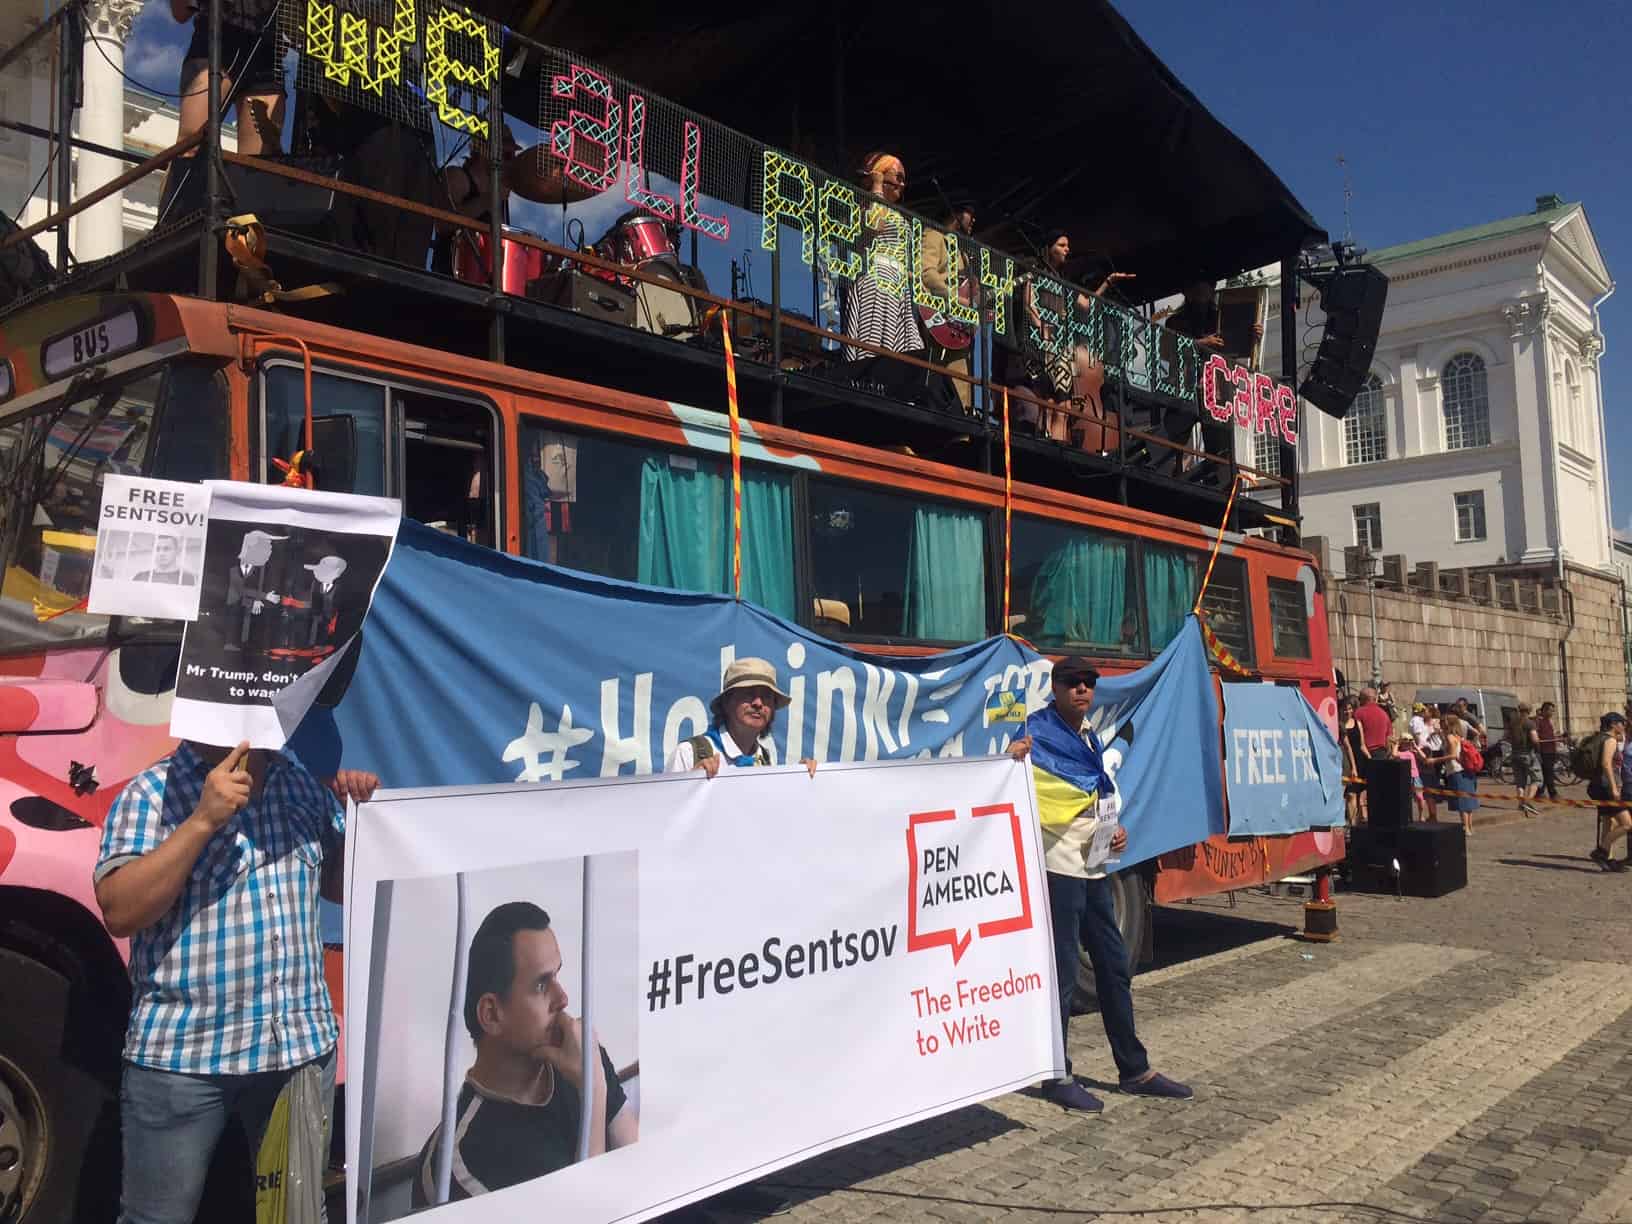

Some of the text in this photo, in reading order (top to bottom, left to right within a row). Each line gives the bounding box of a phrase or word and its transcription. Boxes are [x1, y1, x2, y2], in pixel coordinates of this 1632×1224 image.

[73, 325, 109, 362] BUS
[103, 504, 205, 527] SENTSOV!
[129, 487, 185, 508] FREE
[186, 663, 298, 684] Mr Trump, don't
[229, 686, 280, 699] to was
[1232, 728, 1320, 785] FREE PR
[923, 844, 960, 876] PEN
[1200, 841, 1247, 880] FUNKY
[921, 869, 1015, 909] AMERICA
[647, 924, 898, 1012] #FreeSentsov
[910, 967, 1042, 1018] The Freedom
[916, 1014, 1001, 1057] to Write
